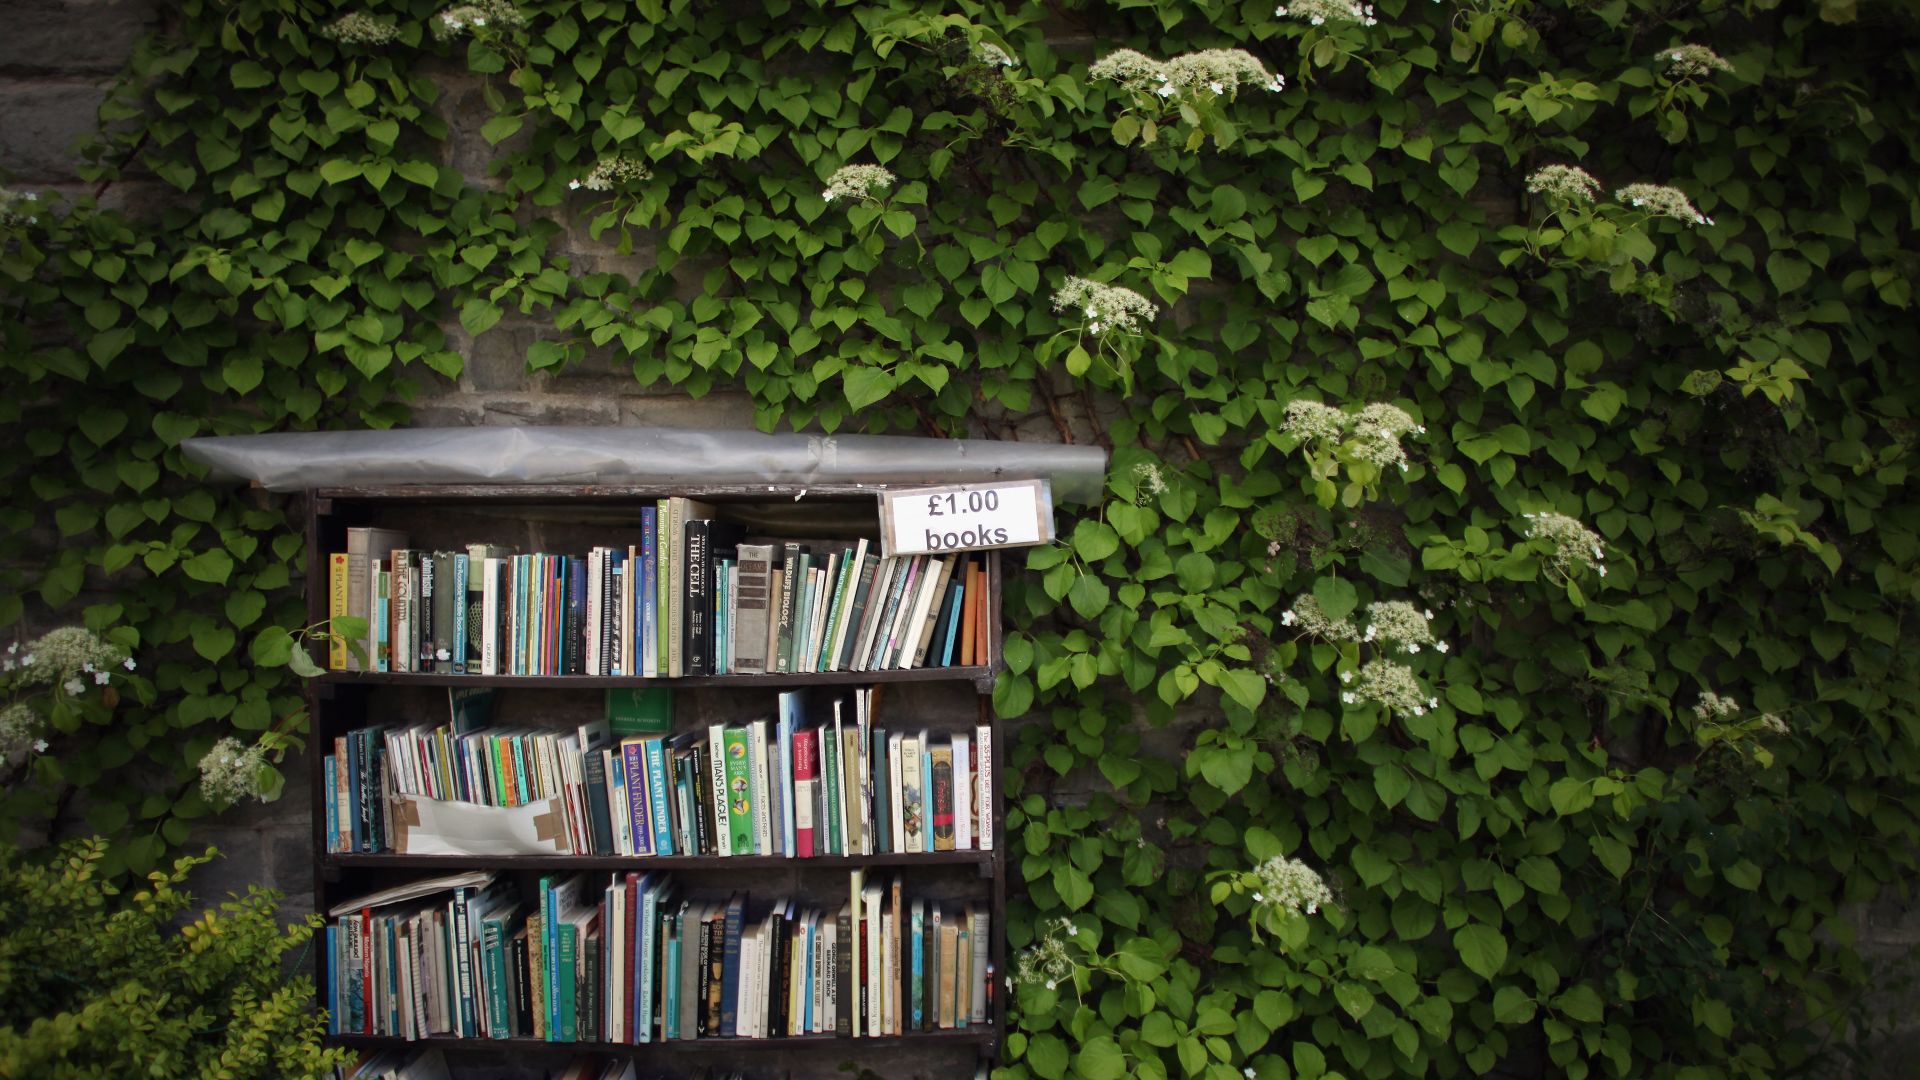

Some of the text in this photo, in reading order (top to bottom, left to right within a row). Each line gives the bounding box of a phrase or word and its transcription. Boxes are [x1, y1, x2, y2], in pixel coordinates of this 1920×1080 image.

[928, 490, 999, 517] £1.00
[657, 505, 667, 535] Planning
[672, 509, 680, 535] WORLD
[925, 524, 1009, 550] books
[422, 557, 434, 575] John
[659, 541, 667, 567] Garden
[689, 534, 700, 598] THE CELL
[422, 575, 434, 598] Huston
[456, 569, 464, 596] Roadside
[781, 557, 794, 628] WILDLIFE BIOLOGY
[835, 568, 846, 597] PRACTICAL
[629, 761, 642, 790] PLANT
[714, 760, 724, 787] MAN'S
[651, 750, 667, 833] THE PLANT FINDER
[632, 792, 645, 826] FINDER
[456, 891, 465, 904] THE
[458, 914, 467, 942] GARDEN
[460, 943, 468, 962] BOOK
[460, 963, 468, 972] OF
[461, 972, 470, 999] EUROPE
